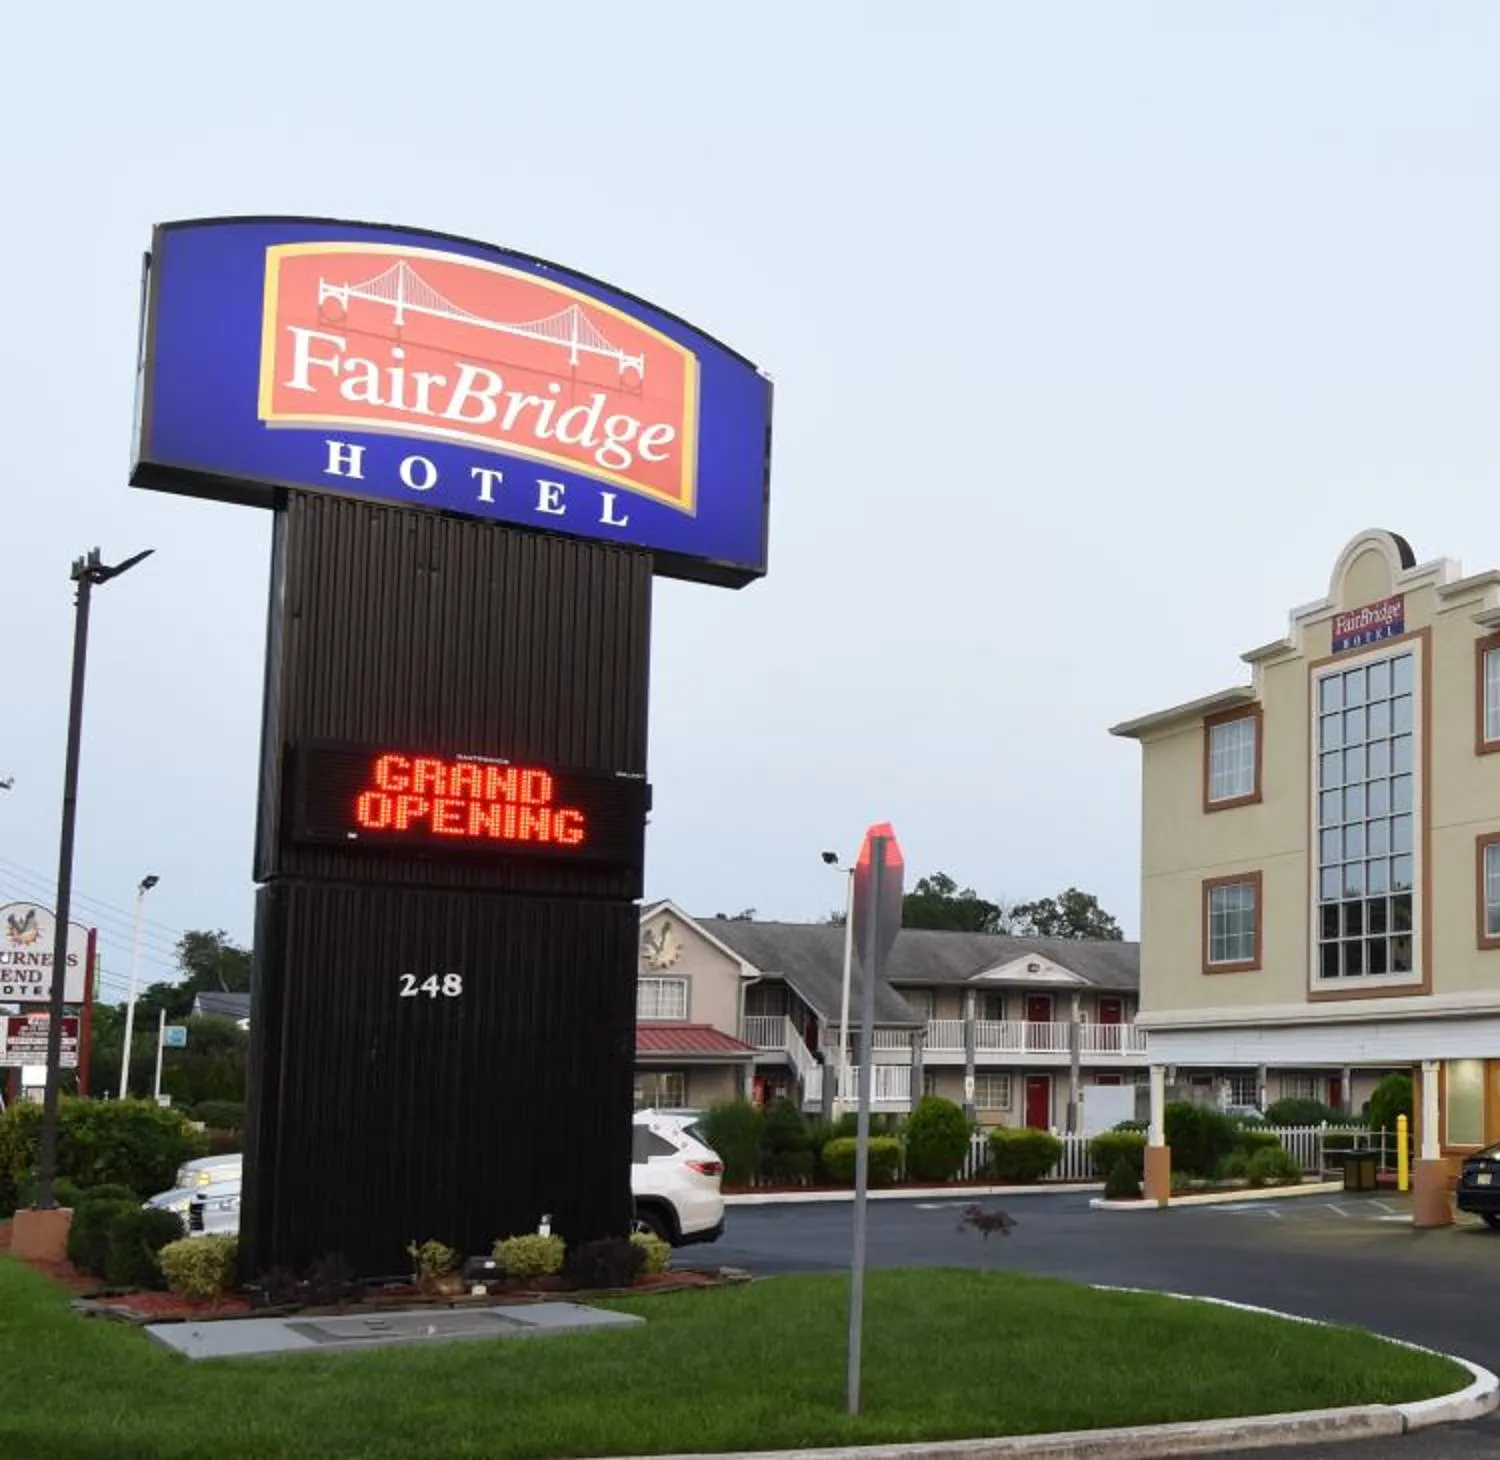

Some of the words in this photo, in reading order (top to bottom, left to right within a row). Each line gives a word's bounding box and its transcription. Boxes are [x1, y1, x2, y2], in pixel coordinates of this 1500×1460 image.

[284, 325, 676, 471] FairBridge
[324, 440, 629, 528] HOTEL
[376, 755, 552, 804] GRAND
[358, 791, 584, 844] OPENING
[3, 985, 53, 995] OTE
[399, 973, 463, 999] 248
